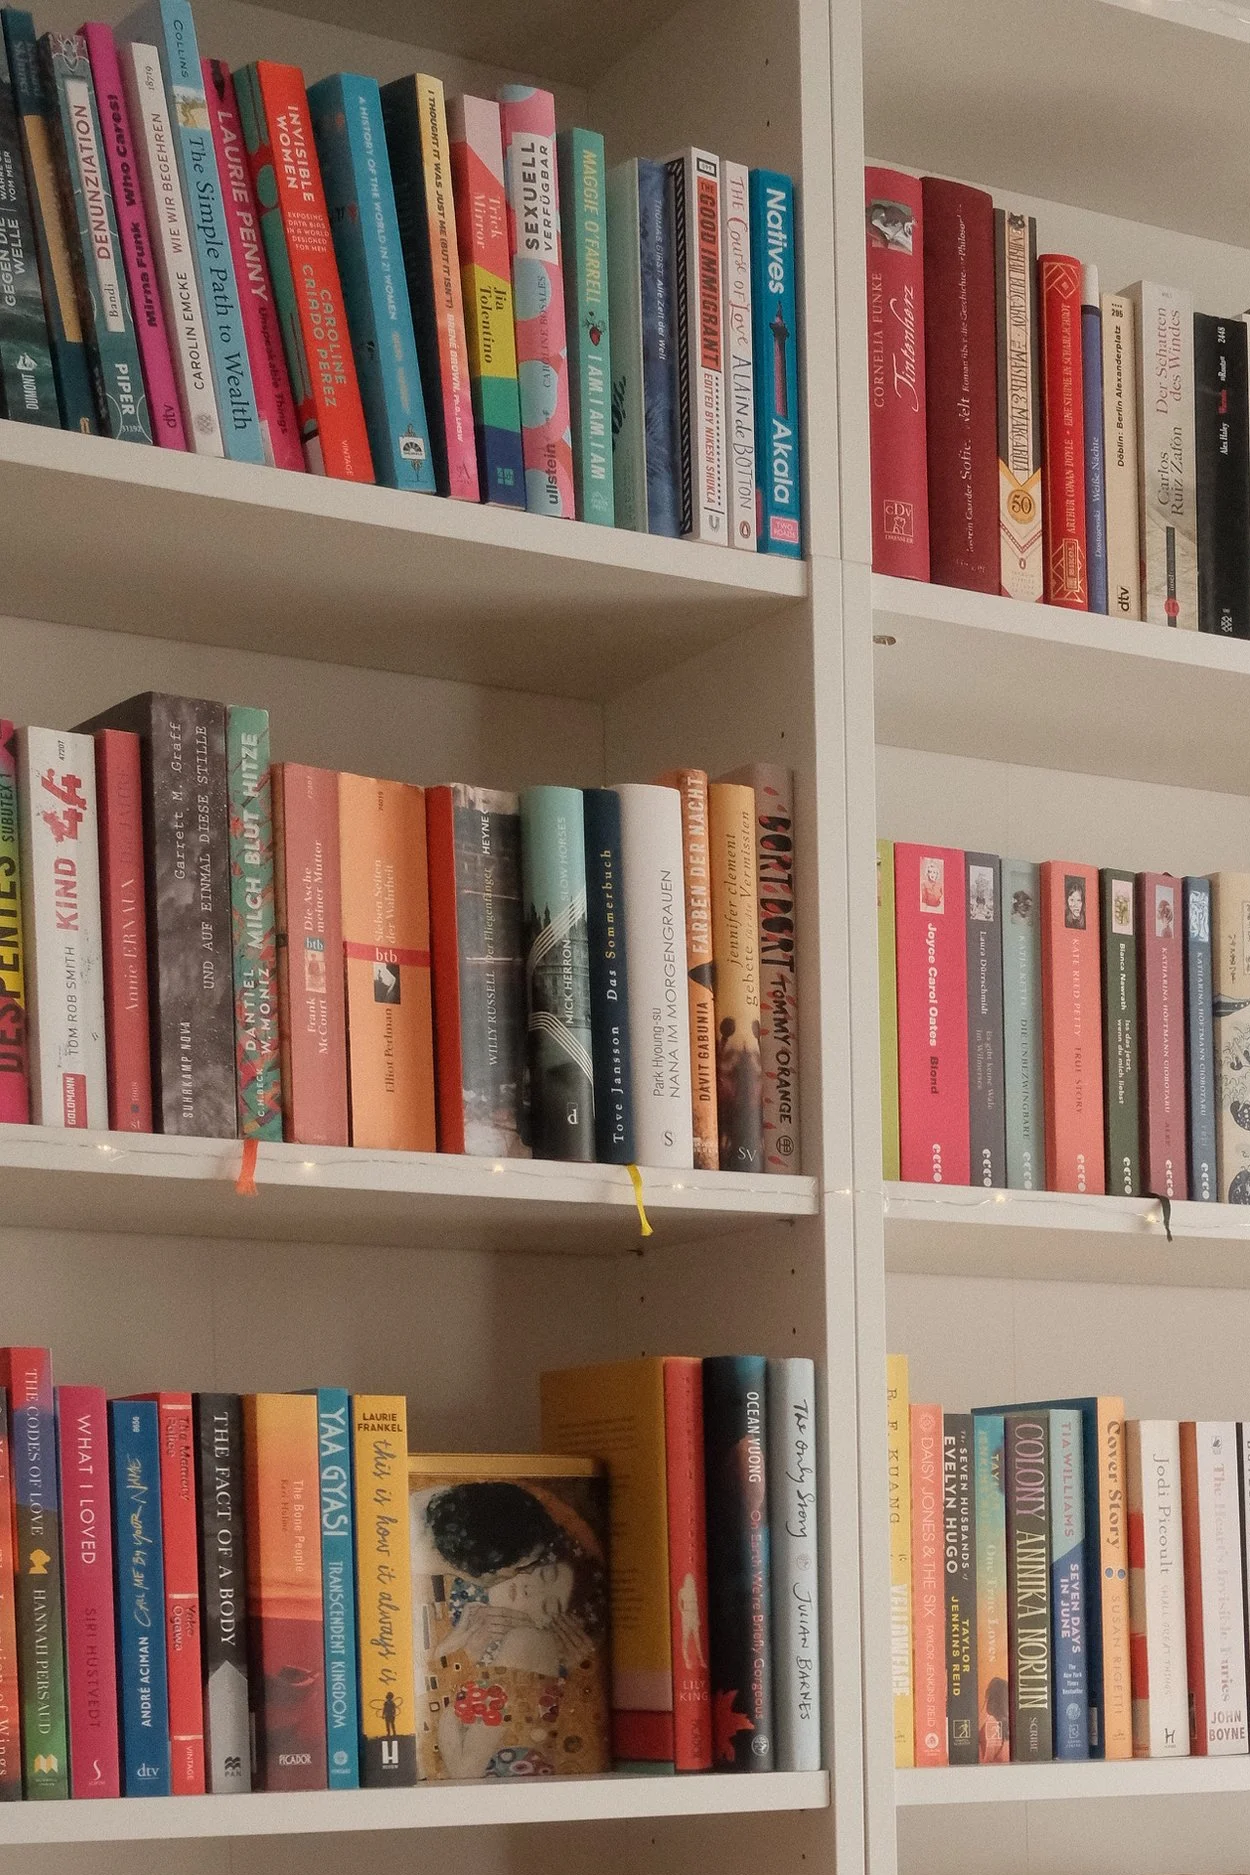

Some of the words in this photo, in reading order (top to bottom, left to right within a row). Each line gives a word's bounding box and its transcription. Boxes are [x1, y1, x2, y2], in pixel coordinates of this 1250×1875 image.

[189, 138, 203, 174] The
[276, 115, 299, 189] WOMEN
[288, 105, 314, 202] INVISIBLE
[75, 104, 112, 259] DENUNZIATION
[525, 142, 539, 249] SEXUELL
[539, 145, 553, 250] VERFÜGBAR
[196, 180, 220, 258] Simple
[766, 187, 784, 294] Natives
[211, 268, 227, 316] Path
[219, 323, 231, 343] to
[893, 285, 920, 412] Tintenherz
[1115, 325, 1123, 398] Alexanderplatz
[224, 353, 248, 431] Wealth
[1116, 400, 1124, 429] Berlin
[770, 419, 790, 503] Akala
[1117, 431, 1125, 467] Döblin:
[1118, 586, 1130, 612] dtv
[241, 732, 259, 794] HITZE
[245, 810, 262, 867] BLUT
[482, 814, 490, 855] HEYNE
[56, 855, 78, 931] KIND
[246, 874, 263, 948] MILCH
[600, 849, 616, 959] Sommerbuch
[660, 870, 677, 1019] MORGENGRAUEN
[926, 923, 937, 964] Joyce
[607, 969, 618, 1001] Das
[928, 968, 937, 1004] Carol
[668, 1024, 680, 1045] IM
[929, 1007, 938, 1047] Oates
[610, 1026, 624, 1094] Jansson
[669, 1048, 680, 1098] NANA
[930, 1056, 939, 1095] Blond
[67, 1077, 76, 1125] GOLDMANN
[612, 1103, 625, 1143] Tove
[214, 1412, 229, 1458] THE
[320, 1407, 346, 1457] YAA
[357, 1423, 402, 1433] FRANKEL
[362, 1412, 397, 1423] LAURIE
[746, 1391, 758, 1434] OCEAN
[747, 1436, 761, 1483] VUONG
[1015, 1423, 1045, 1521] COLONY
[1154, 1453, 1169, 1496] Jodi
[215, 1468, 231, 1522] FACT
[322, 1467, 347, 1536] GYASI
[218, 1529, 232, 1556] OF
[1157, 1503, 1171, 1576] Picoult
[219, 1564, 232, 1579] A
[1016, 1530, 1046, 1620] ANNIKA
[219, 1587, 235, 1647] BODY
[1018, 1626, 1048, 1709] NORLIN
[279, 1754, 312, 1766] PICADOR
